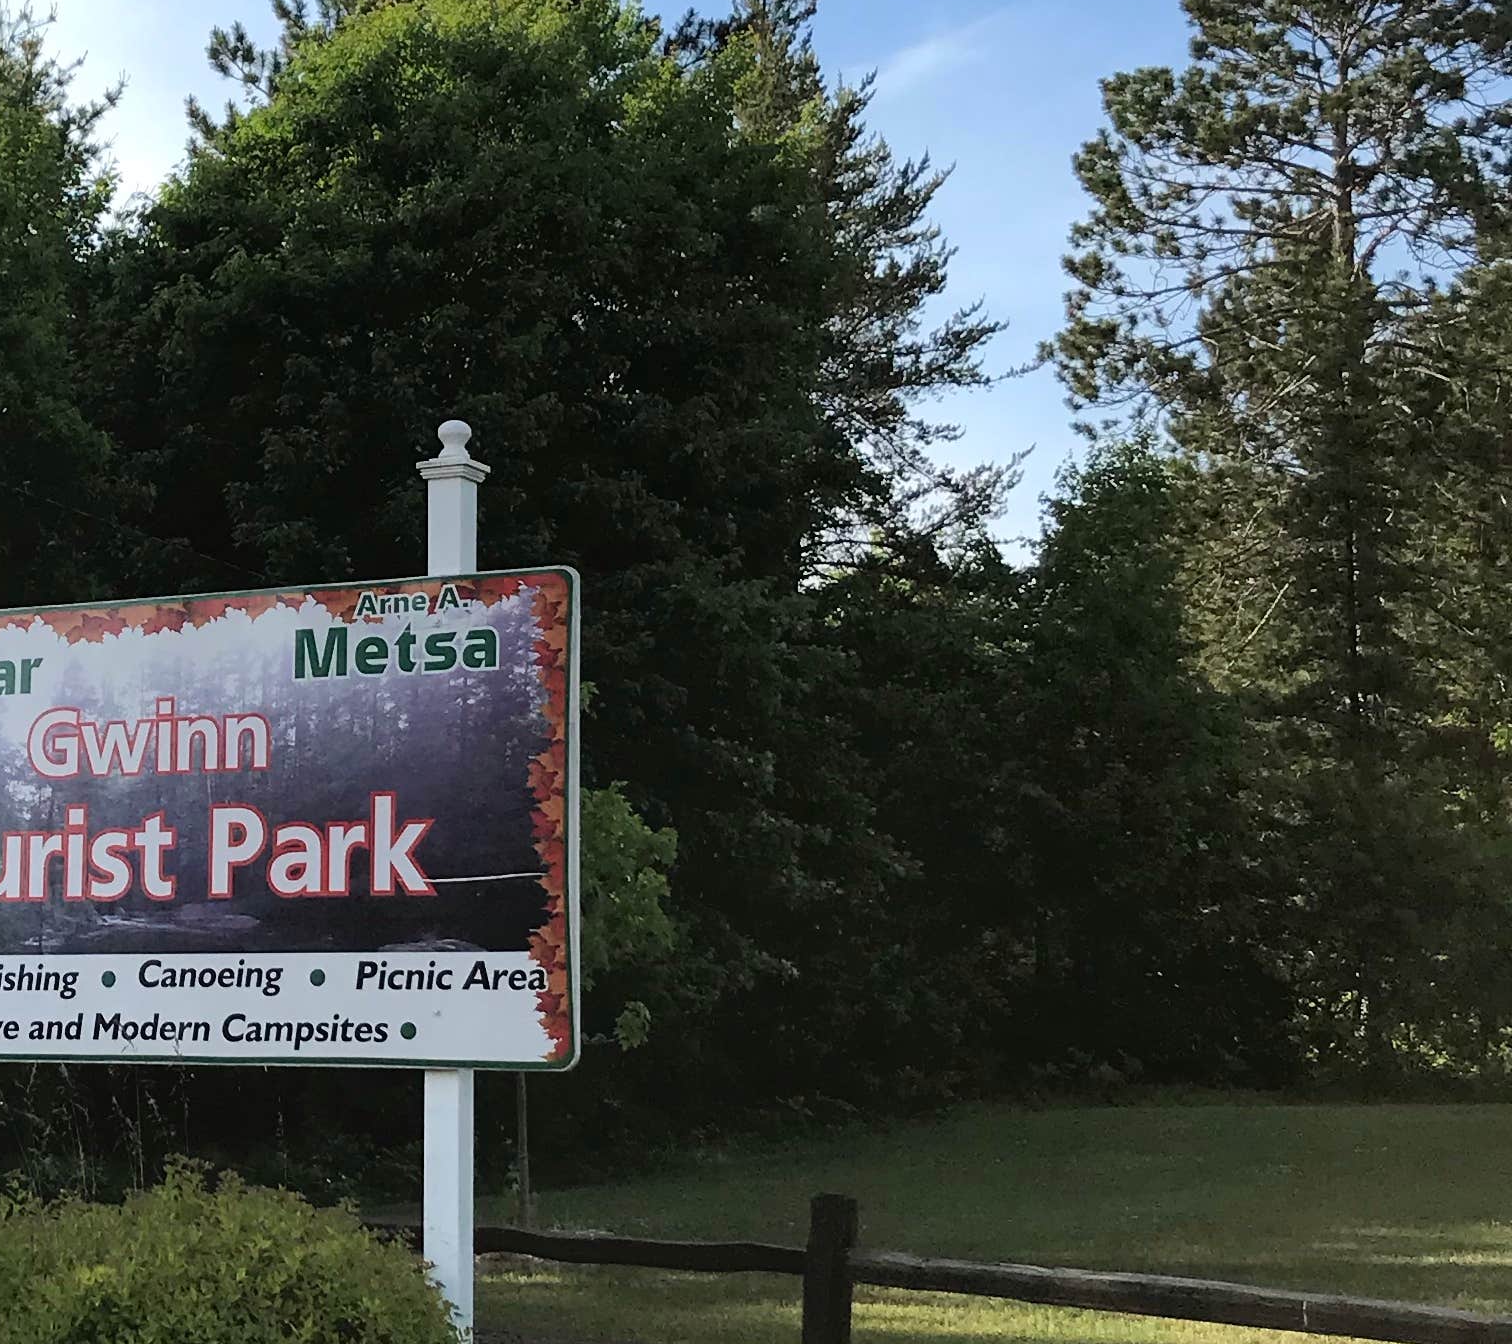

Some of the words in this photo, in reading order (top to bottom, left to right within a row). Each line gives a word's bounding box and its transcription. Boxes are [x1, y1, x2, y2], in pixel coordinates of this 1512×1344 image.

[357, 593, 427, 616] Arne
[438, 587, 469, 609] A.
[294, 624, 498, 679] Metsa
[28, 696, 272, 779] Gwinn
[208, 791, 437, 898] Park
[139, 959, 284, 996] Canoeing
[356, 960, 452, 990] Picnic
[463, 960, 547, 991] Area
[29, 1013, 83, 1041] and
[93, 1013, 210, 1042] Modern
[222, 1013, 388, 1051] Campsites
